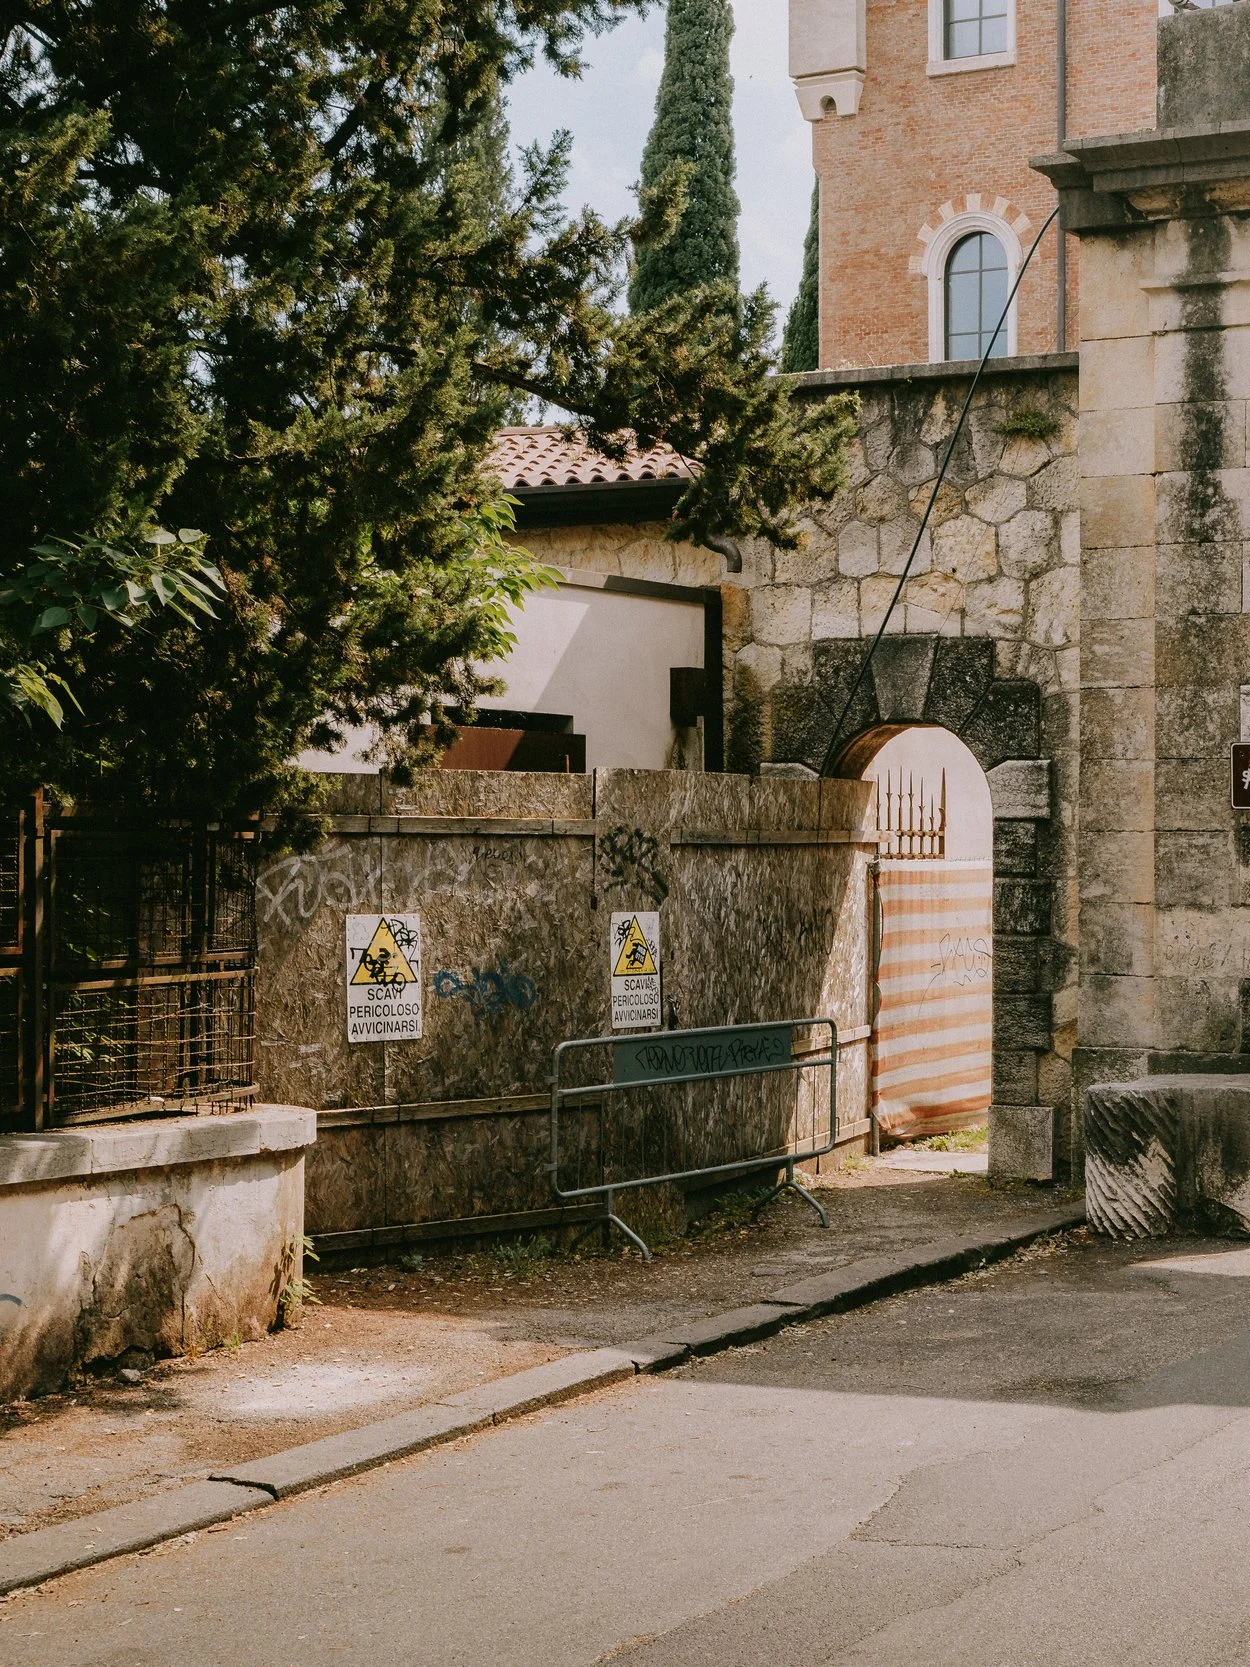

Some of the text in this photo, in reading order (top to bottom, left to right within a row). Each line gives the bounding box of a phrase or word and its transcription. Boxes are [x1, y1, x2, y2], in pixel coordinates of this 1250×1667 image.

[624, 978, 648, 991] SCAVI
[367, 988, 402, 1001] SCAVI
[612, 993, 659, 1007] PERICOLOSO
[349, 1003, 419, 1018] PERICOLOSO
[614, 1008, 658, 1022] AVVICINARSI
[351, 1020, 418, 1035] AVVICINARSI
